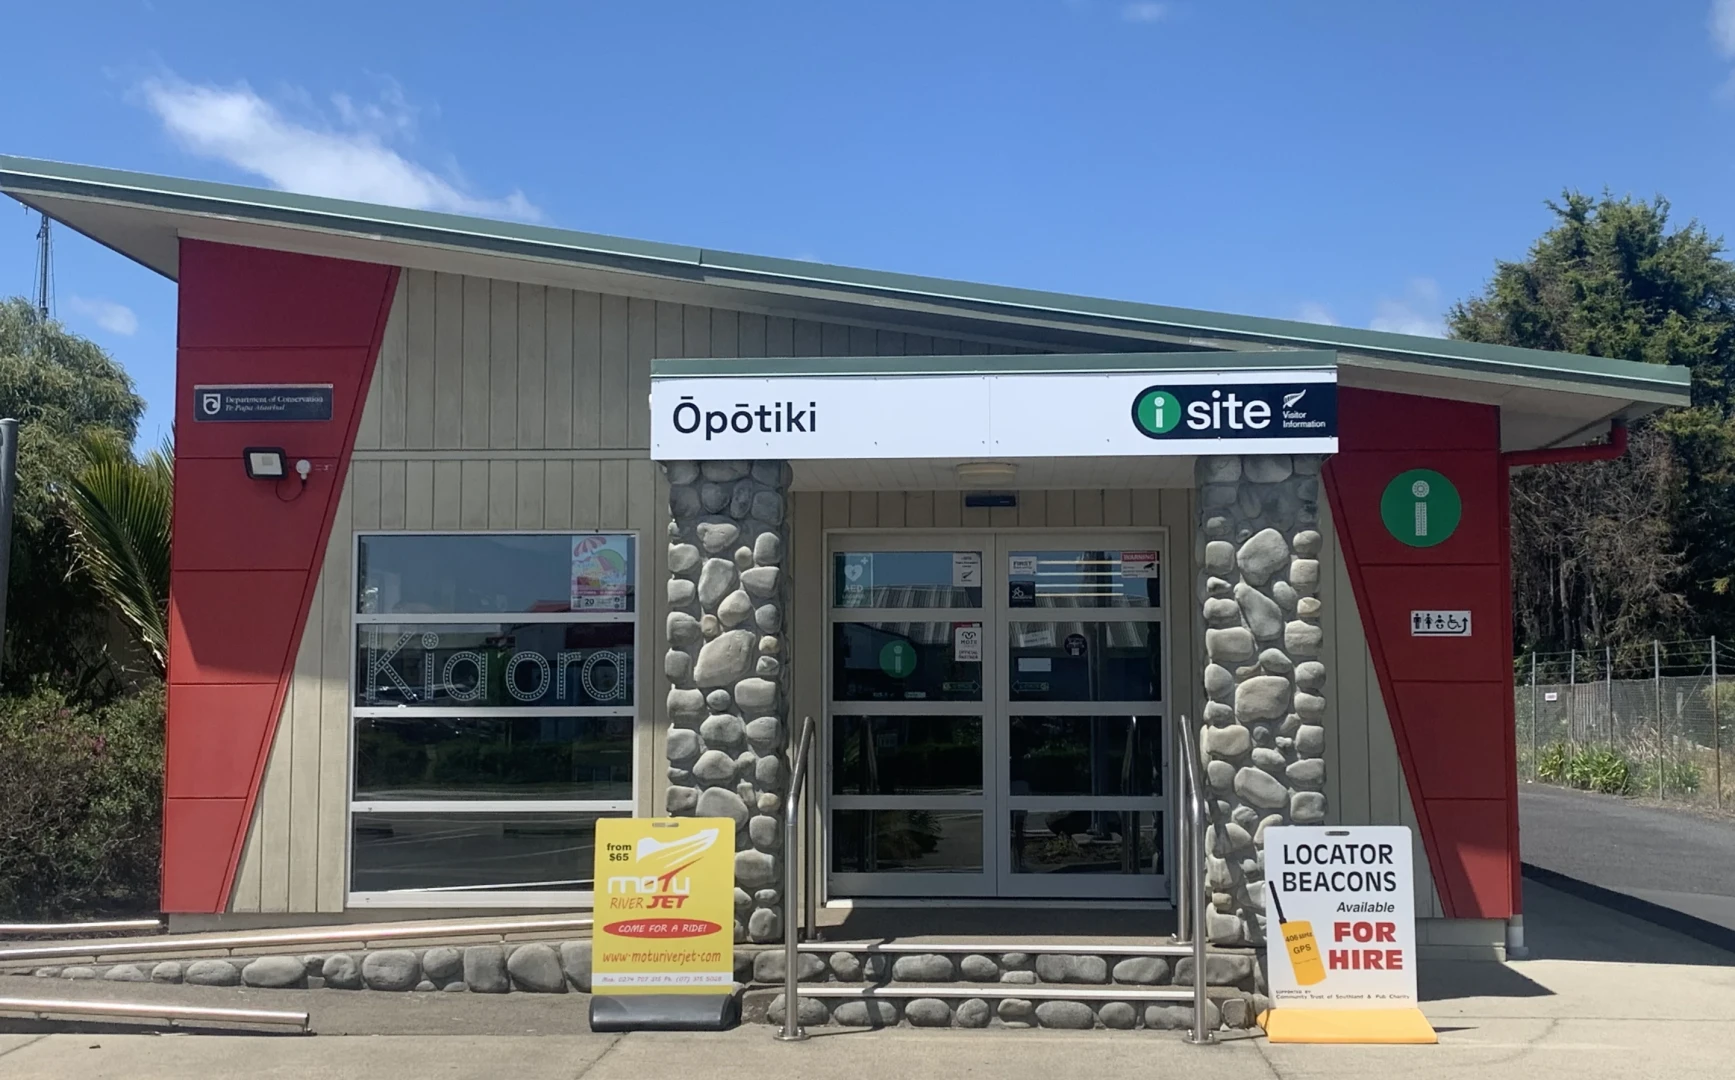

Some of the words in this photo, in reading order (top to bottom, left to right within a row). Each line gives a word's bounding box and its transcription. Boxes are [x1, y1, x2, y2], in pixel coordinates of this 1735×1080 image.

[225, 396, 267, 404] Department
[1187, 390, 1271, 430] site
[1282, 411, 1307, 419] Visitor
[673, 396, 816, 441] Ōpōtiki
[1282, 419, 1326, 428] Information
[844, 584, 864, 593] AED
[366, 630, 487, 701] Kia
[505, 650, 627, 701] ora
[606, 843, 632, 851] from
[609, 853, 629, 862] $65
[1283, 844, 1394, 865] LOCATOR
[1282, 871, 1397, 892] BEACONS
[609, 897, 644, 910] RIVER
[646, 895, 690, 909] JET
[1336, 901, 1395, 913] Available
[618, 924, 645, 933] COME
[648, 924, 668, 932] FOR
[671, 924, 678, 932] A
[682, 924, 707, 932] RIDE!
[1333, 921, 1397, 943] FOR
[1293, 943, 1312, 955] GPS
[1329, 949, 1403, 970] HIRE
